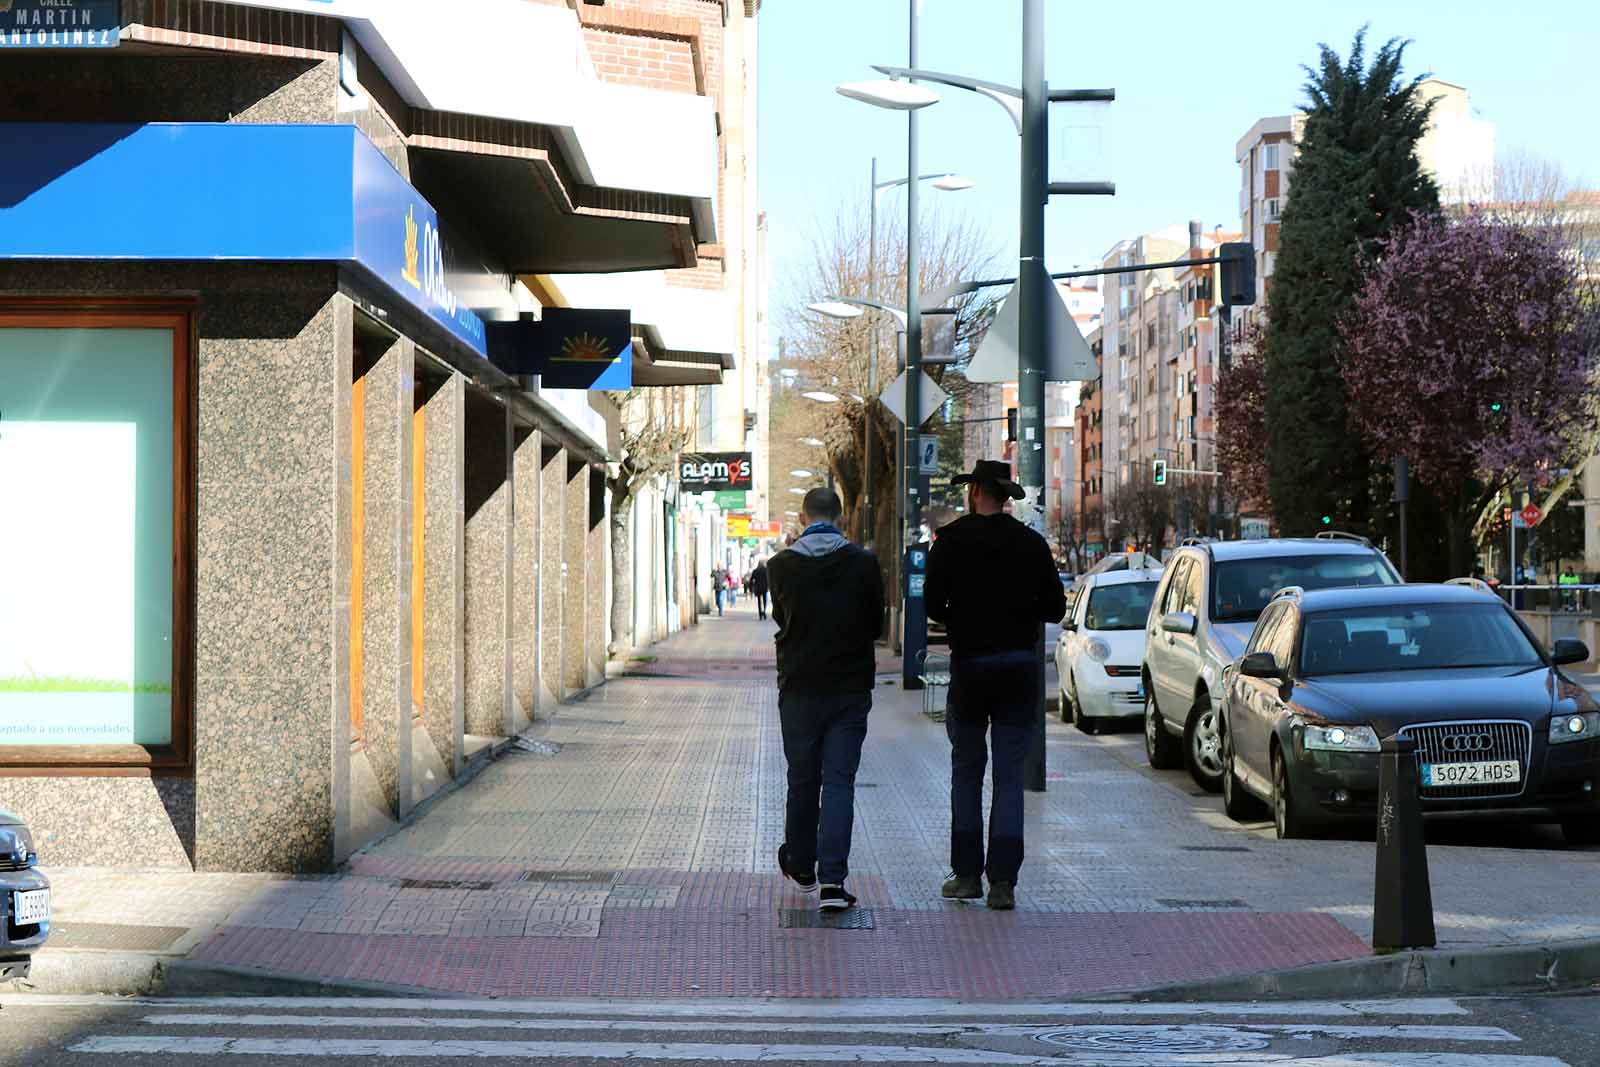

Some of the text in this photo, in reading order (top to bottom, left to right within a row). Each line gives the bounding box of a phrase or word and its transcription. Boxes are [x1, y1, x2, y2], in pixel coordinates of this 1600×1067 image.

[16, 8, 91, 25] MARTIN
[0, 28, 109, 45] ANTOLINEZ
[913, 551, 924, 566] P
[1437, 766, 1478, 782] 5072
[1483, 764, 1513, 780] HDS
